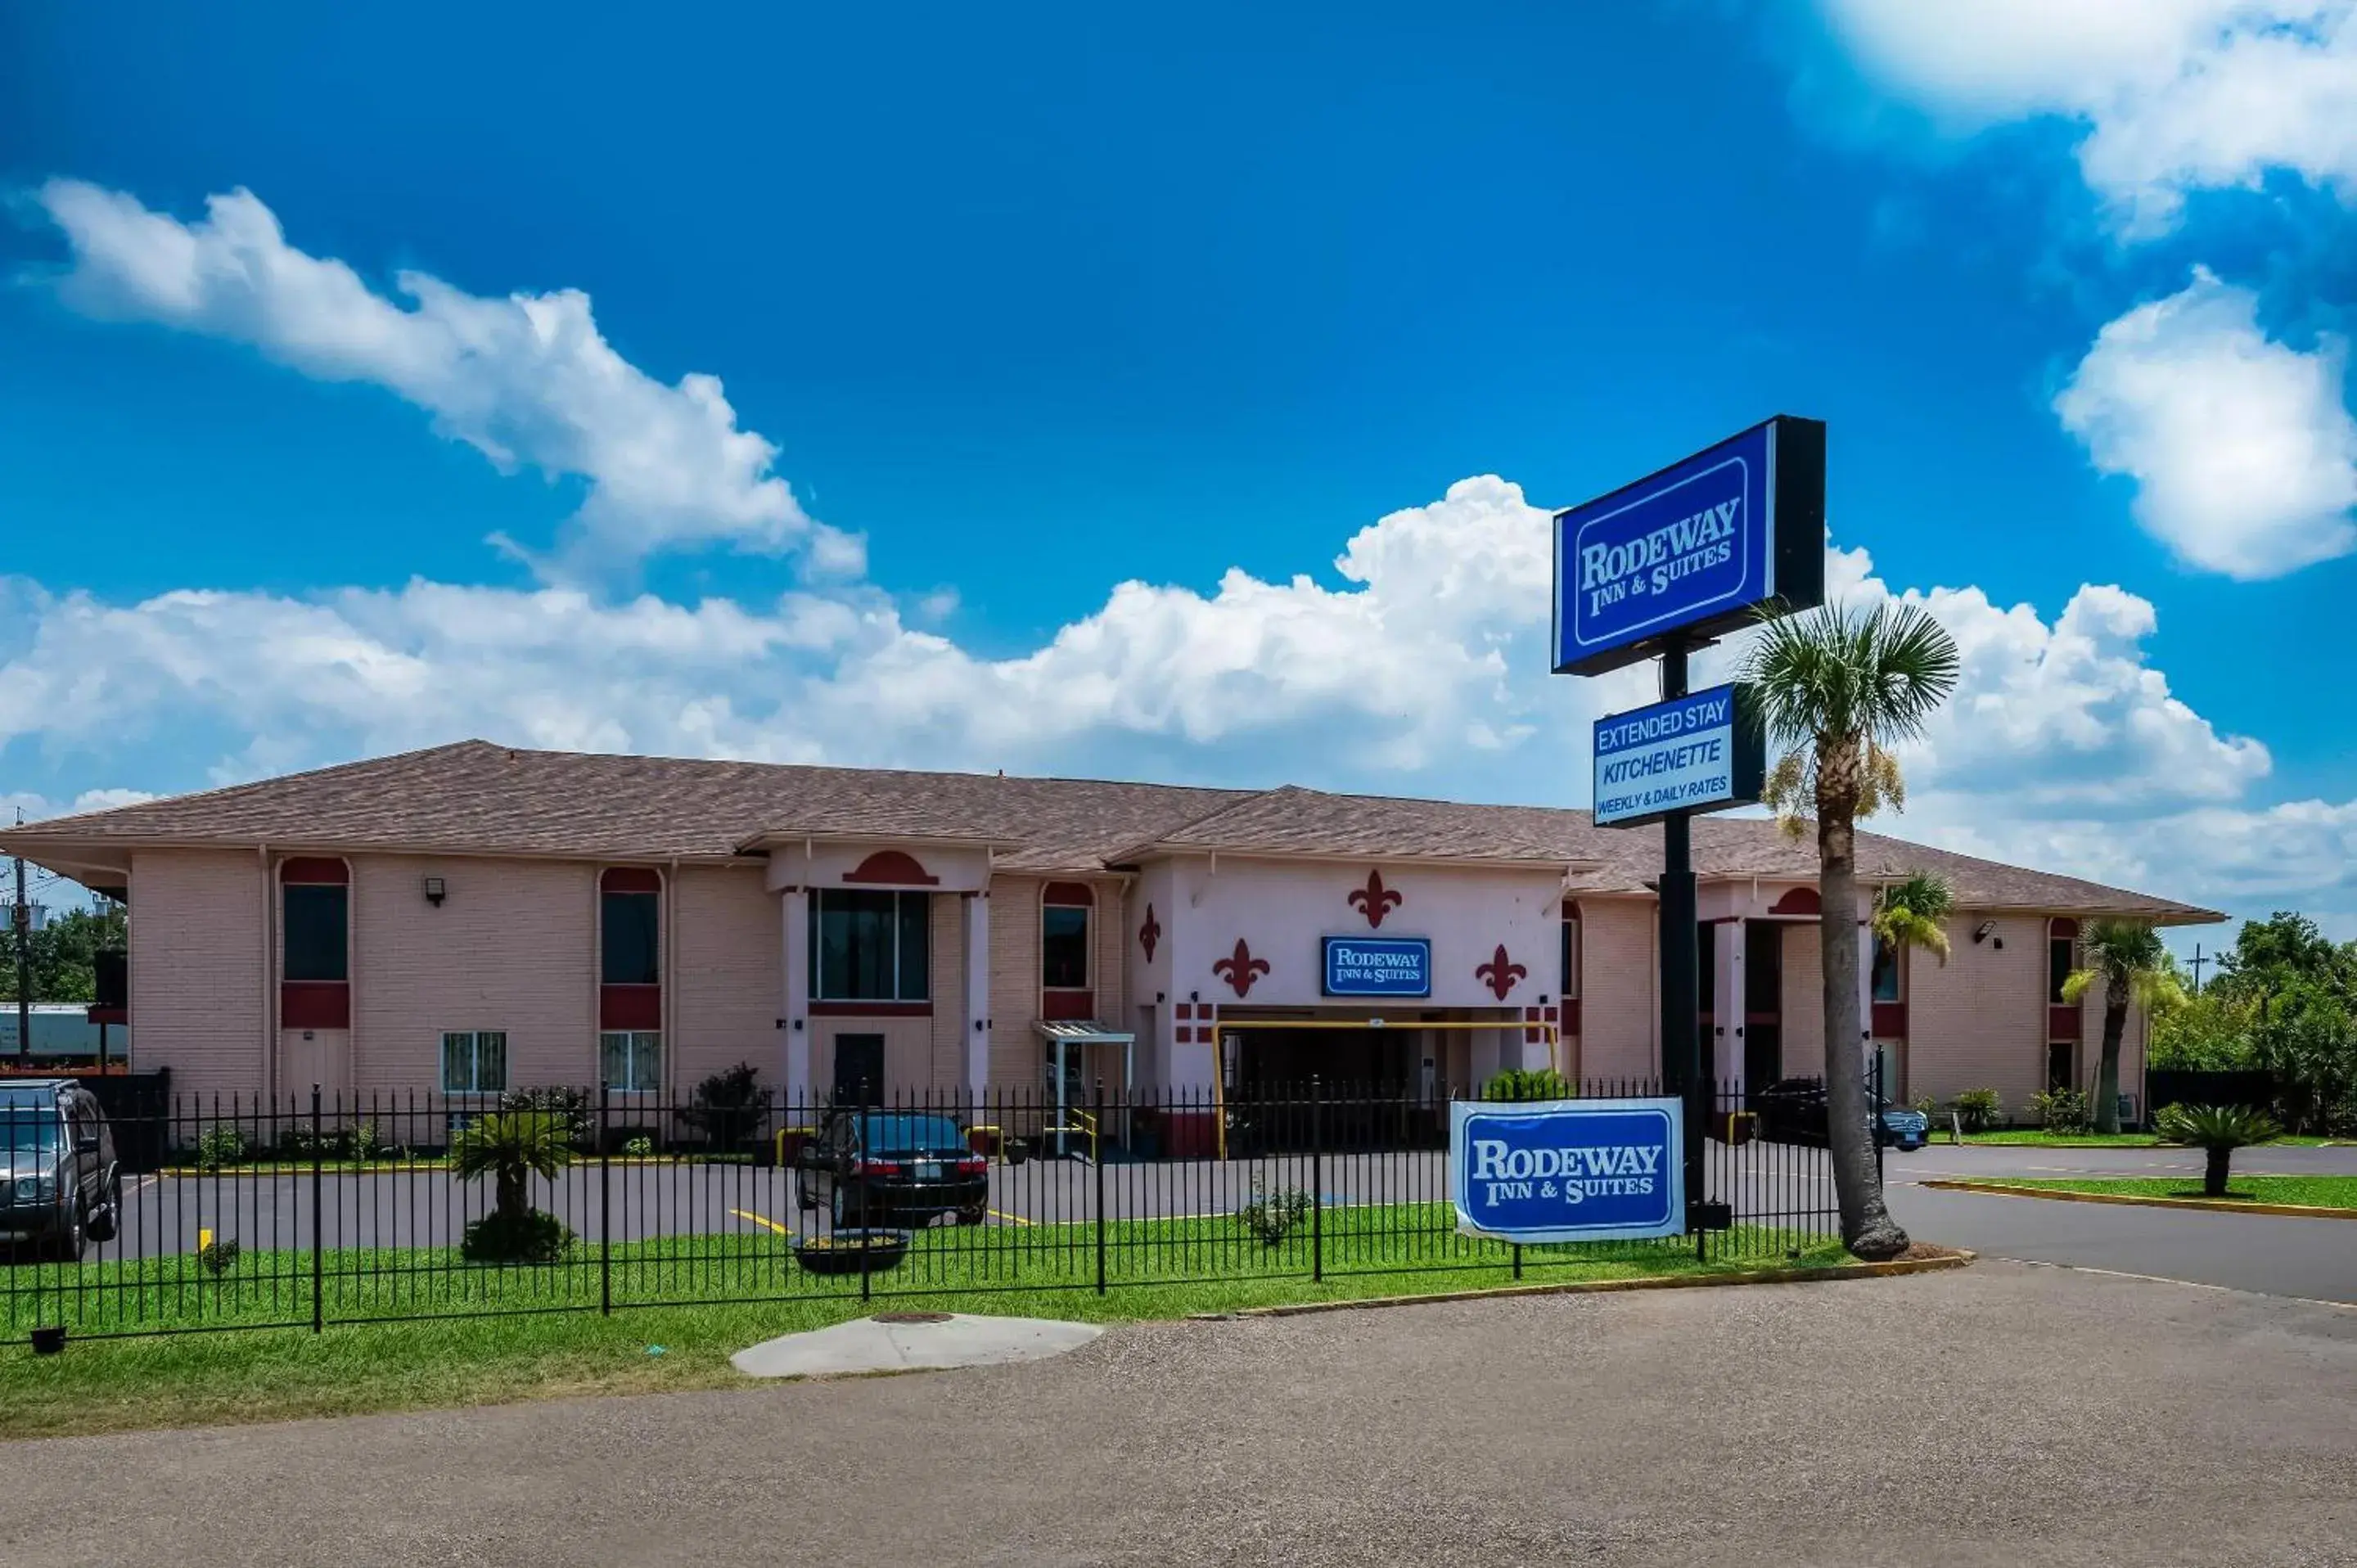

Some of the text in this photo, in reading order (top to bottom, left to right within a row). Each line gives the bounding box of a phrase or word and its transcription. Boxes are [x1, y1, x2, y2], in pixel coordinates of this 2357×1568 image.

[1581, 497, 1741, 592] RODEWAY
[1590, 540, 1731, 617] INN & SUITES
[1598, 698, 1727, 750] EXTENDED STAY
[1603, 738, 1721, 785] KITCHENETTE
[1598, 776, 1727, 814] WEEKLY & DAILY RATES
[1336, 948, 1420, 967] RODEWAY
[1336, 968, 1421, 983] INN & SUITES
[1472, 1139, 1662, 1179] RODEWAY
[1485, 1178, 1654, 1207] INN & SUITES
